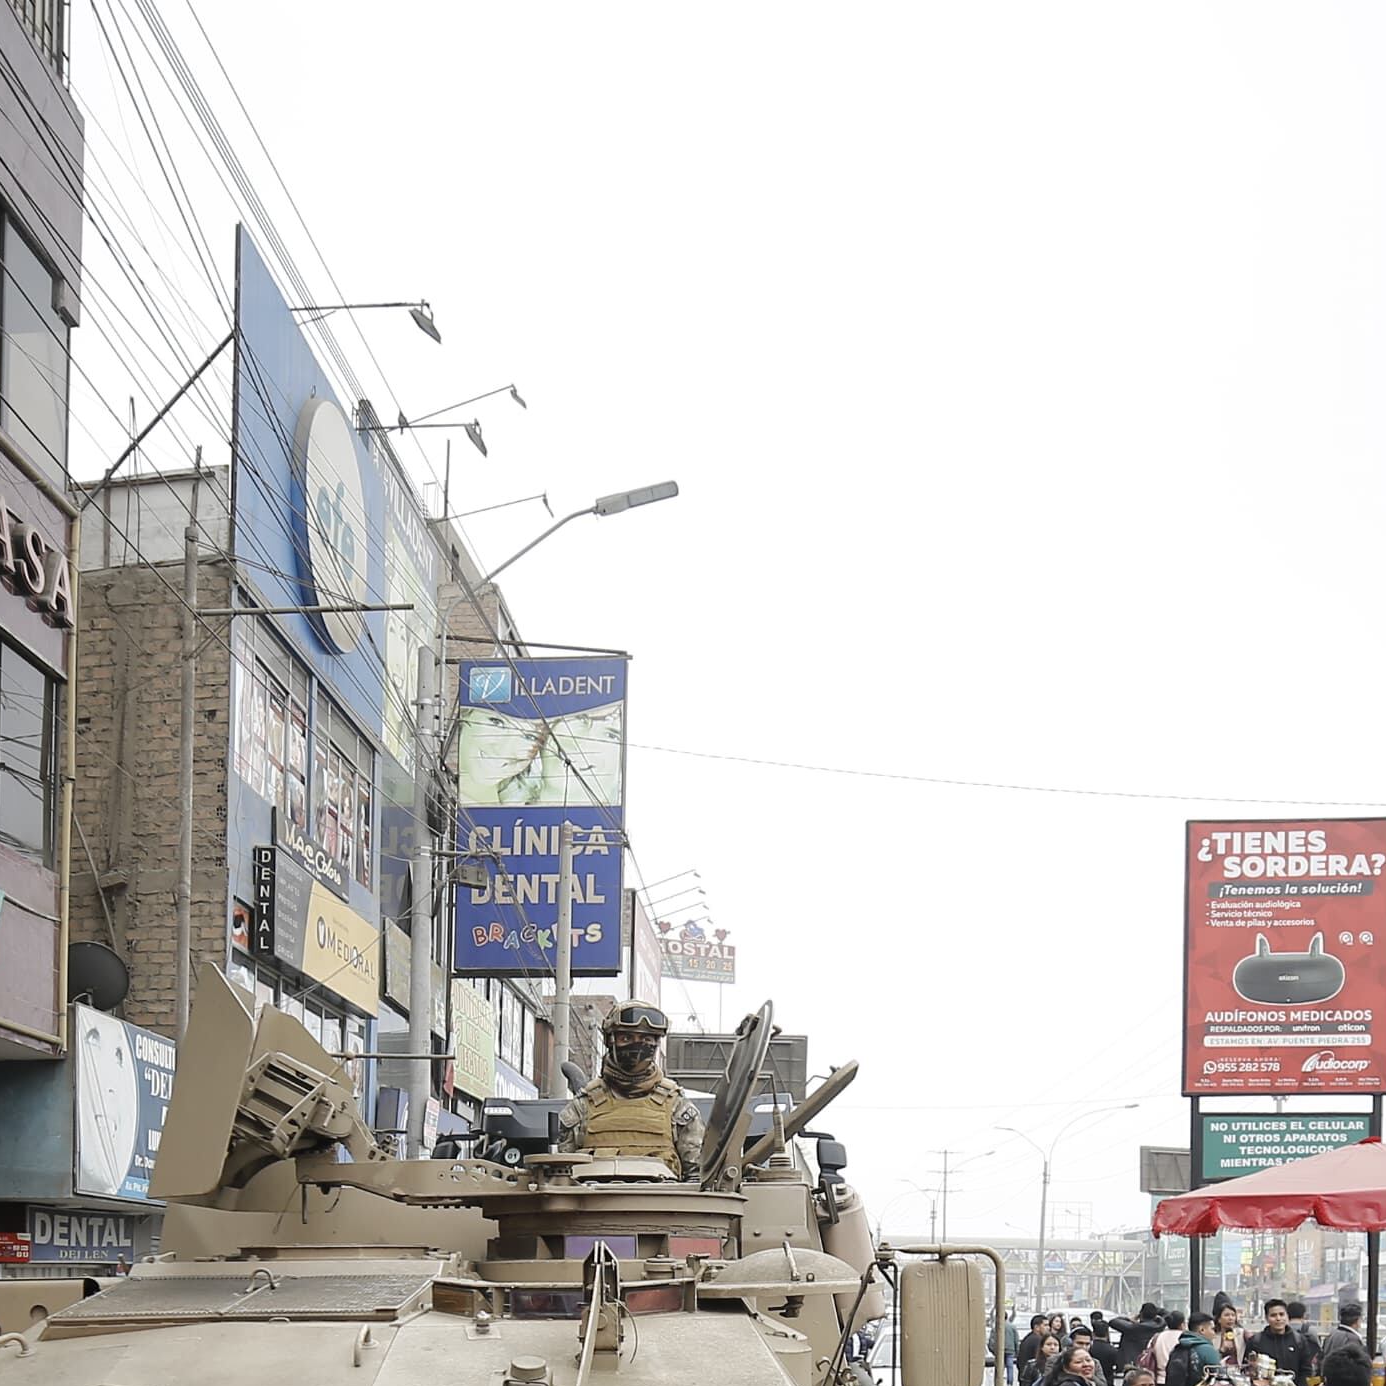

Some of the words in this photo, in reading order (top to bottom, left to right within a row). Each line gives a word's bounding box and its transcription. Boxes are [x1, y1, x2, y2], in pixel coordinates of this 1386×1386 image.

[468, 819, 610, 857] CLÍNICA
[1197, 830, 1327, 862] ¿TIENES
[1223, 853, 1386, 878] SORDERA?
[470, 873, 607, 905] DENTAL
[1219, 884, 1281, 898] ¡Tenemos
[1285, 883, 1298, 895] la
[1301, 882, 1363, 895] solución!
[258, 850, 272, 950] DENTAL
[1210, 901, 1254, 909] Evaluación
[1255, 900, 1301, 910] audiológica
[1210, 910, 1243, 918] Servicio
[1243, 910, 1273, 918] técnico
[1210, 919, 1234, 927] Venta
[1235, 919, 1246, 927] de
[1273, 918, 1315, 926] accesorios
[472, 922, 603, 950] BRACKTS
[1204, 1009, 1286, 1022] AUDÍFONOS
[1290, 1009, 1373, 1022] MEDICADOS
[1210, 1025, 1263, 1033] RESPALDADOS
[1292, 1024, 1321, 1032] unitron
[1338, 1023, 1366, 1031] oticon
[1217, 1063, 1238, 1072] 955
[1239, 1062, 1260, 1072] 282
[1260, 1062, 1281, 1072] 578
[1210, 1122, 1228, 1131] NO
[1232, 1121, 1287, 1131] UTILICES
[1290, 1121, 1305, 1130] EL
[1308, 1121, 1365, 1130] CELULAR
[1223, 1134, 1236, 1143] NI
[1239, 1133, 1280, 1143] OTROS
[1284, 1133, 1348, 1143] APARATOS
[1239, 1145, 1335, 1155] TECNOLOGICOS
[1220, 1158, 1283, 1168] MIENTRAS
[34, 1211, 133, 1248] DENTAL
